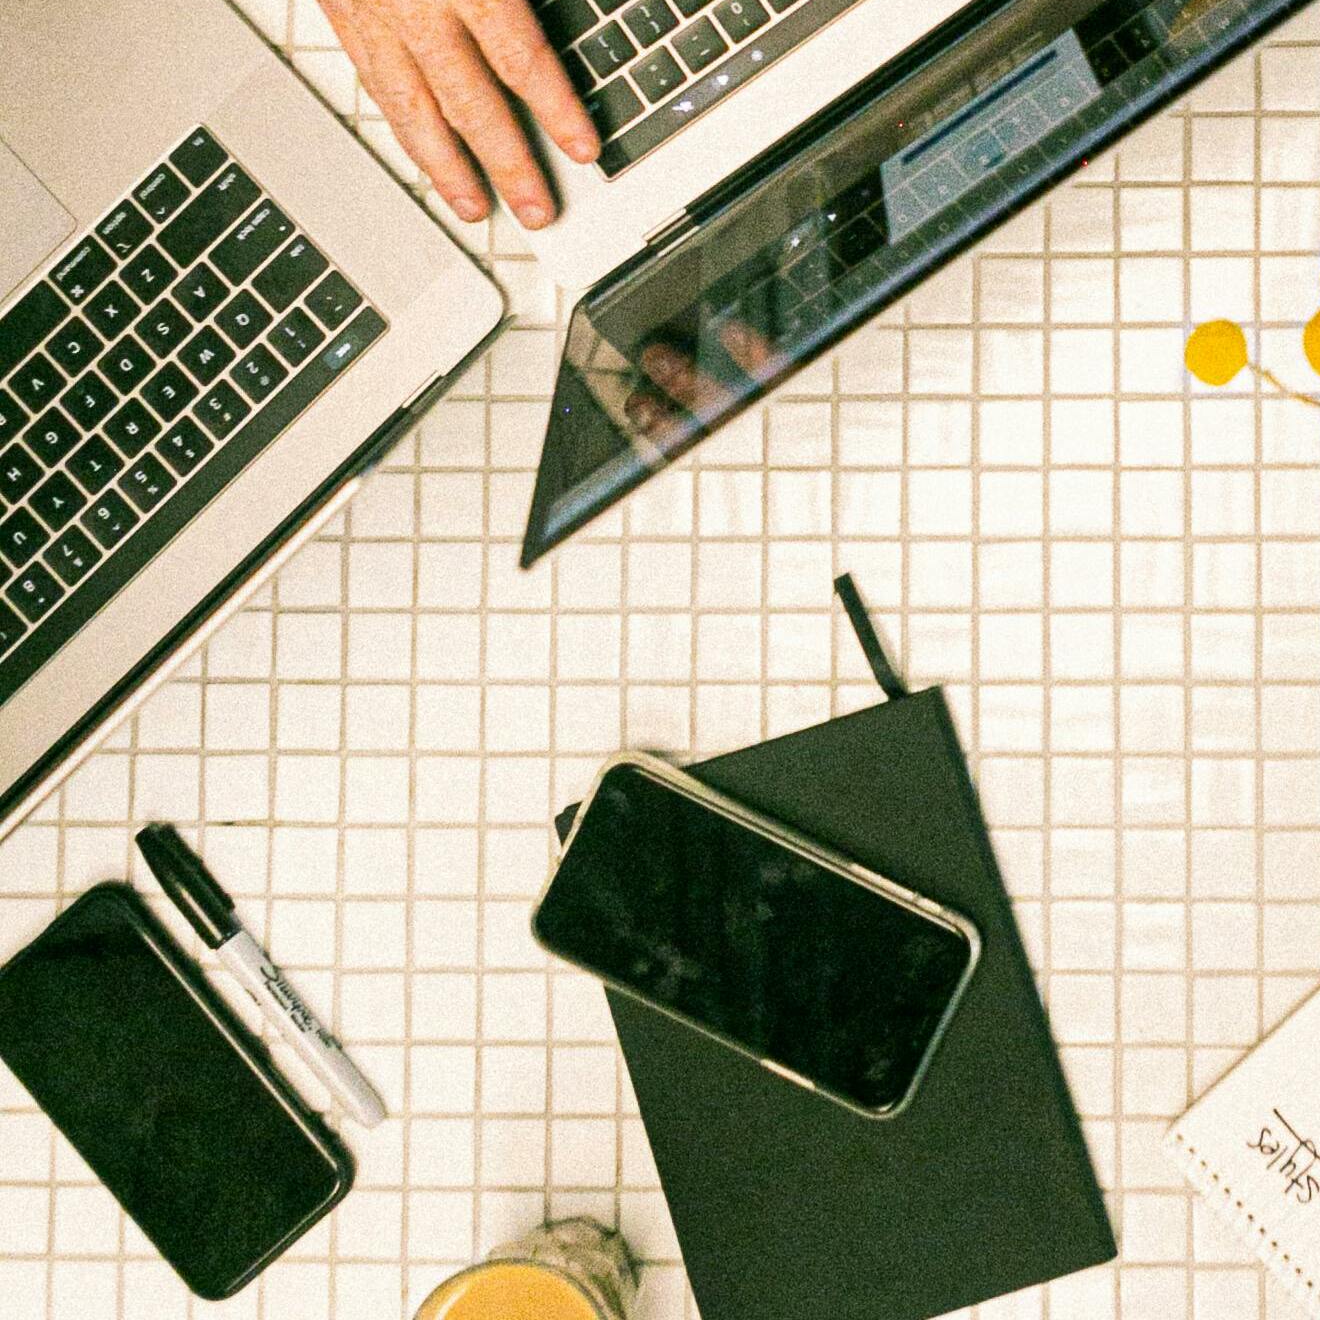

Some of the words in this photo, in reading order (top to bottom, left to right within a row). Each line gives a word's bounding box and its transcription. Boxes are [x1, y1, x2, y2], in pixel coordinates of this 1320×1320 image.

[141, 268, 155, 283] Z
[193, 285, 206, 299] A
[104, 304, 119, 318] X
[235, 313, 251, 327] Q
[156, 322, 171, 336] S
[284, 326, 297, 338] 1
[67, 341, 82, 355] C
[199, 349, 215, 365] W
[119, 358, 134, 372] D
[246, 361, 260, 375] 2
[31, 378, 45, 392] V
[162, 385, 177, 399] E
[85, 394, 97, 409] F
[208, 397, 223, 411] 3
[125, 421, 140, 436] R
[45, 431, 59, 445] G
[171, 435, 184, 448] 4
[89, 459, 103, 472] T
[7, 467, 22, 482] H
[134, 470, 148, 484] 5
[52, 496, 65, 509] Y
[97, 507, 111, 520] 6
[13, 531, 28, 546] U
[62, 544, 74, 558] 7
[22, 579, 36, 593] 8
